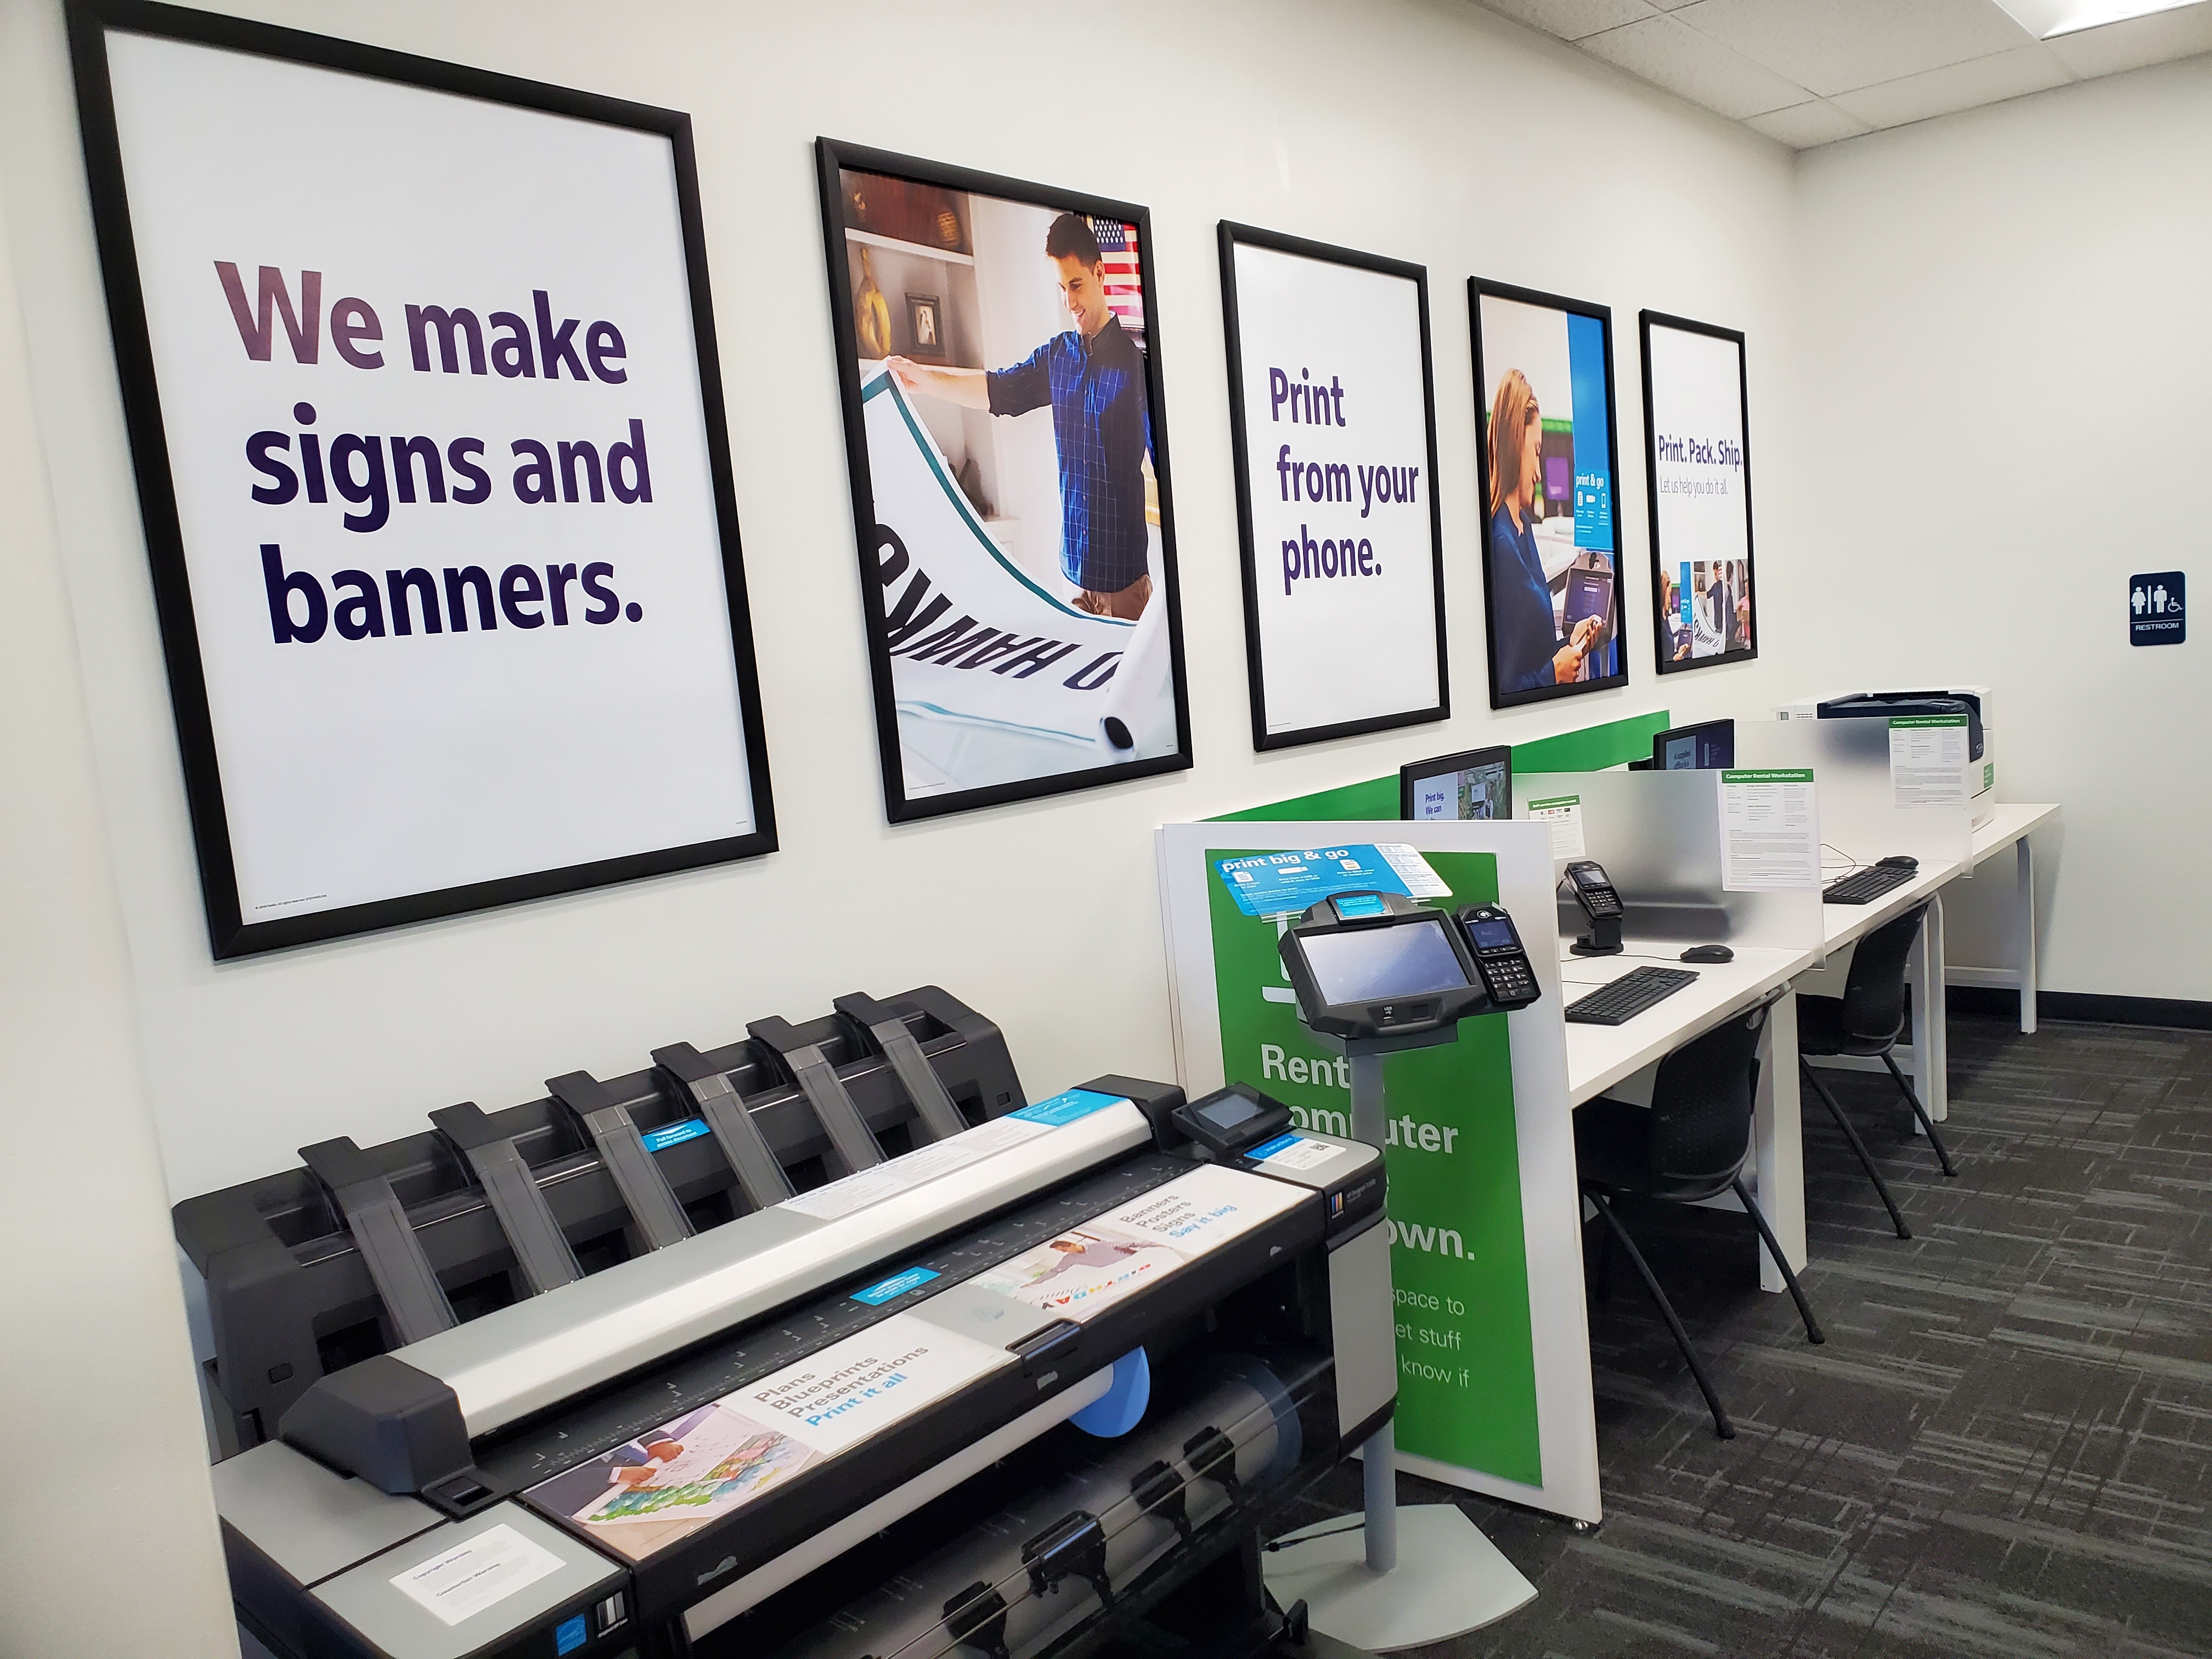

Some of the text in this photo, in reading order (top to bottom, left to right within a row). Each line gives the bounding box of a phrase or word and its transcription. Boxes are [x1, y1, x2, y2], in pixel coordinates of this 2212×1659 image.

[214, 261, 628, 383] We make
[1269, 366, 1346, 427] Print
[245, 402, 653, 533] signs and
[1658, 433, 1742, 472] Print. Pack. Ship.
[1276, 444, 1419, 518] from your
[1576, 472, 1604, 490] print & go
[1660, 476, 1671, 493] Let
[1671, 480, 1679, 494] us
[1679, 476, 1692, 498] help
[1692, 481, 1705, 499] you
[1706, 477, 1714, 494] do
[1714, 478, 1719, 495] it
[1281, 523, 1383, 596] phone.
[259, 544, 643, 644] banners.
[2135, 622, 2180, 631] RESTROOM
[1425, 793, 1436, 804] Print
[1425, 805, 1442, 815] We can
[1221, 849, 1349, 873] print big & go
[1261, 1043, 1351, 1089] Rent
[1288, 1105, 1459, 1154] omuter
[1118, 1194, 1180, 1223] Banners
[1135, 1200, 1192, 1228] Posters
[1152, 1211, 1196, 1233] Signs
[1169, 1205, 1238, 1238] Say it big
[1446, 1296, 1465, 1316] to
[1395, 1323, 1463, 1351] et stuff
[753, 1372, 817, 1403] Plans
[769, 1356, 879, 1410] Blueprints
[787, 1346, 930, 1418] Presentations
[1401, 1353, 1470, 1388] know if
[804, 1373, 909, 1426] Print it all
